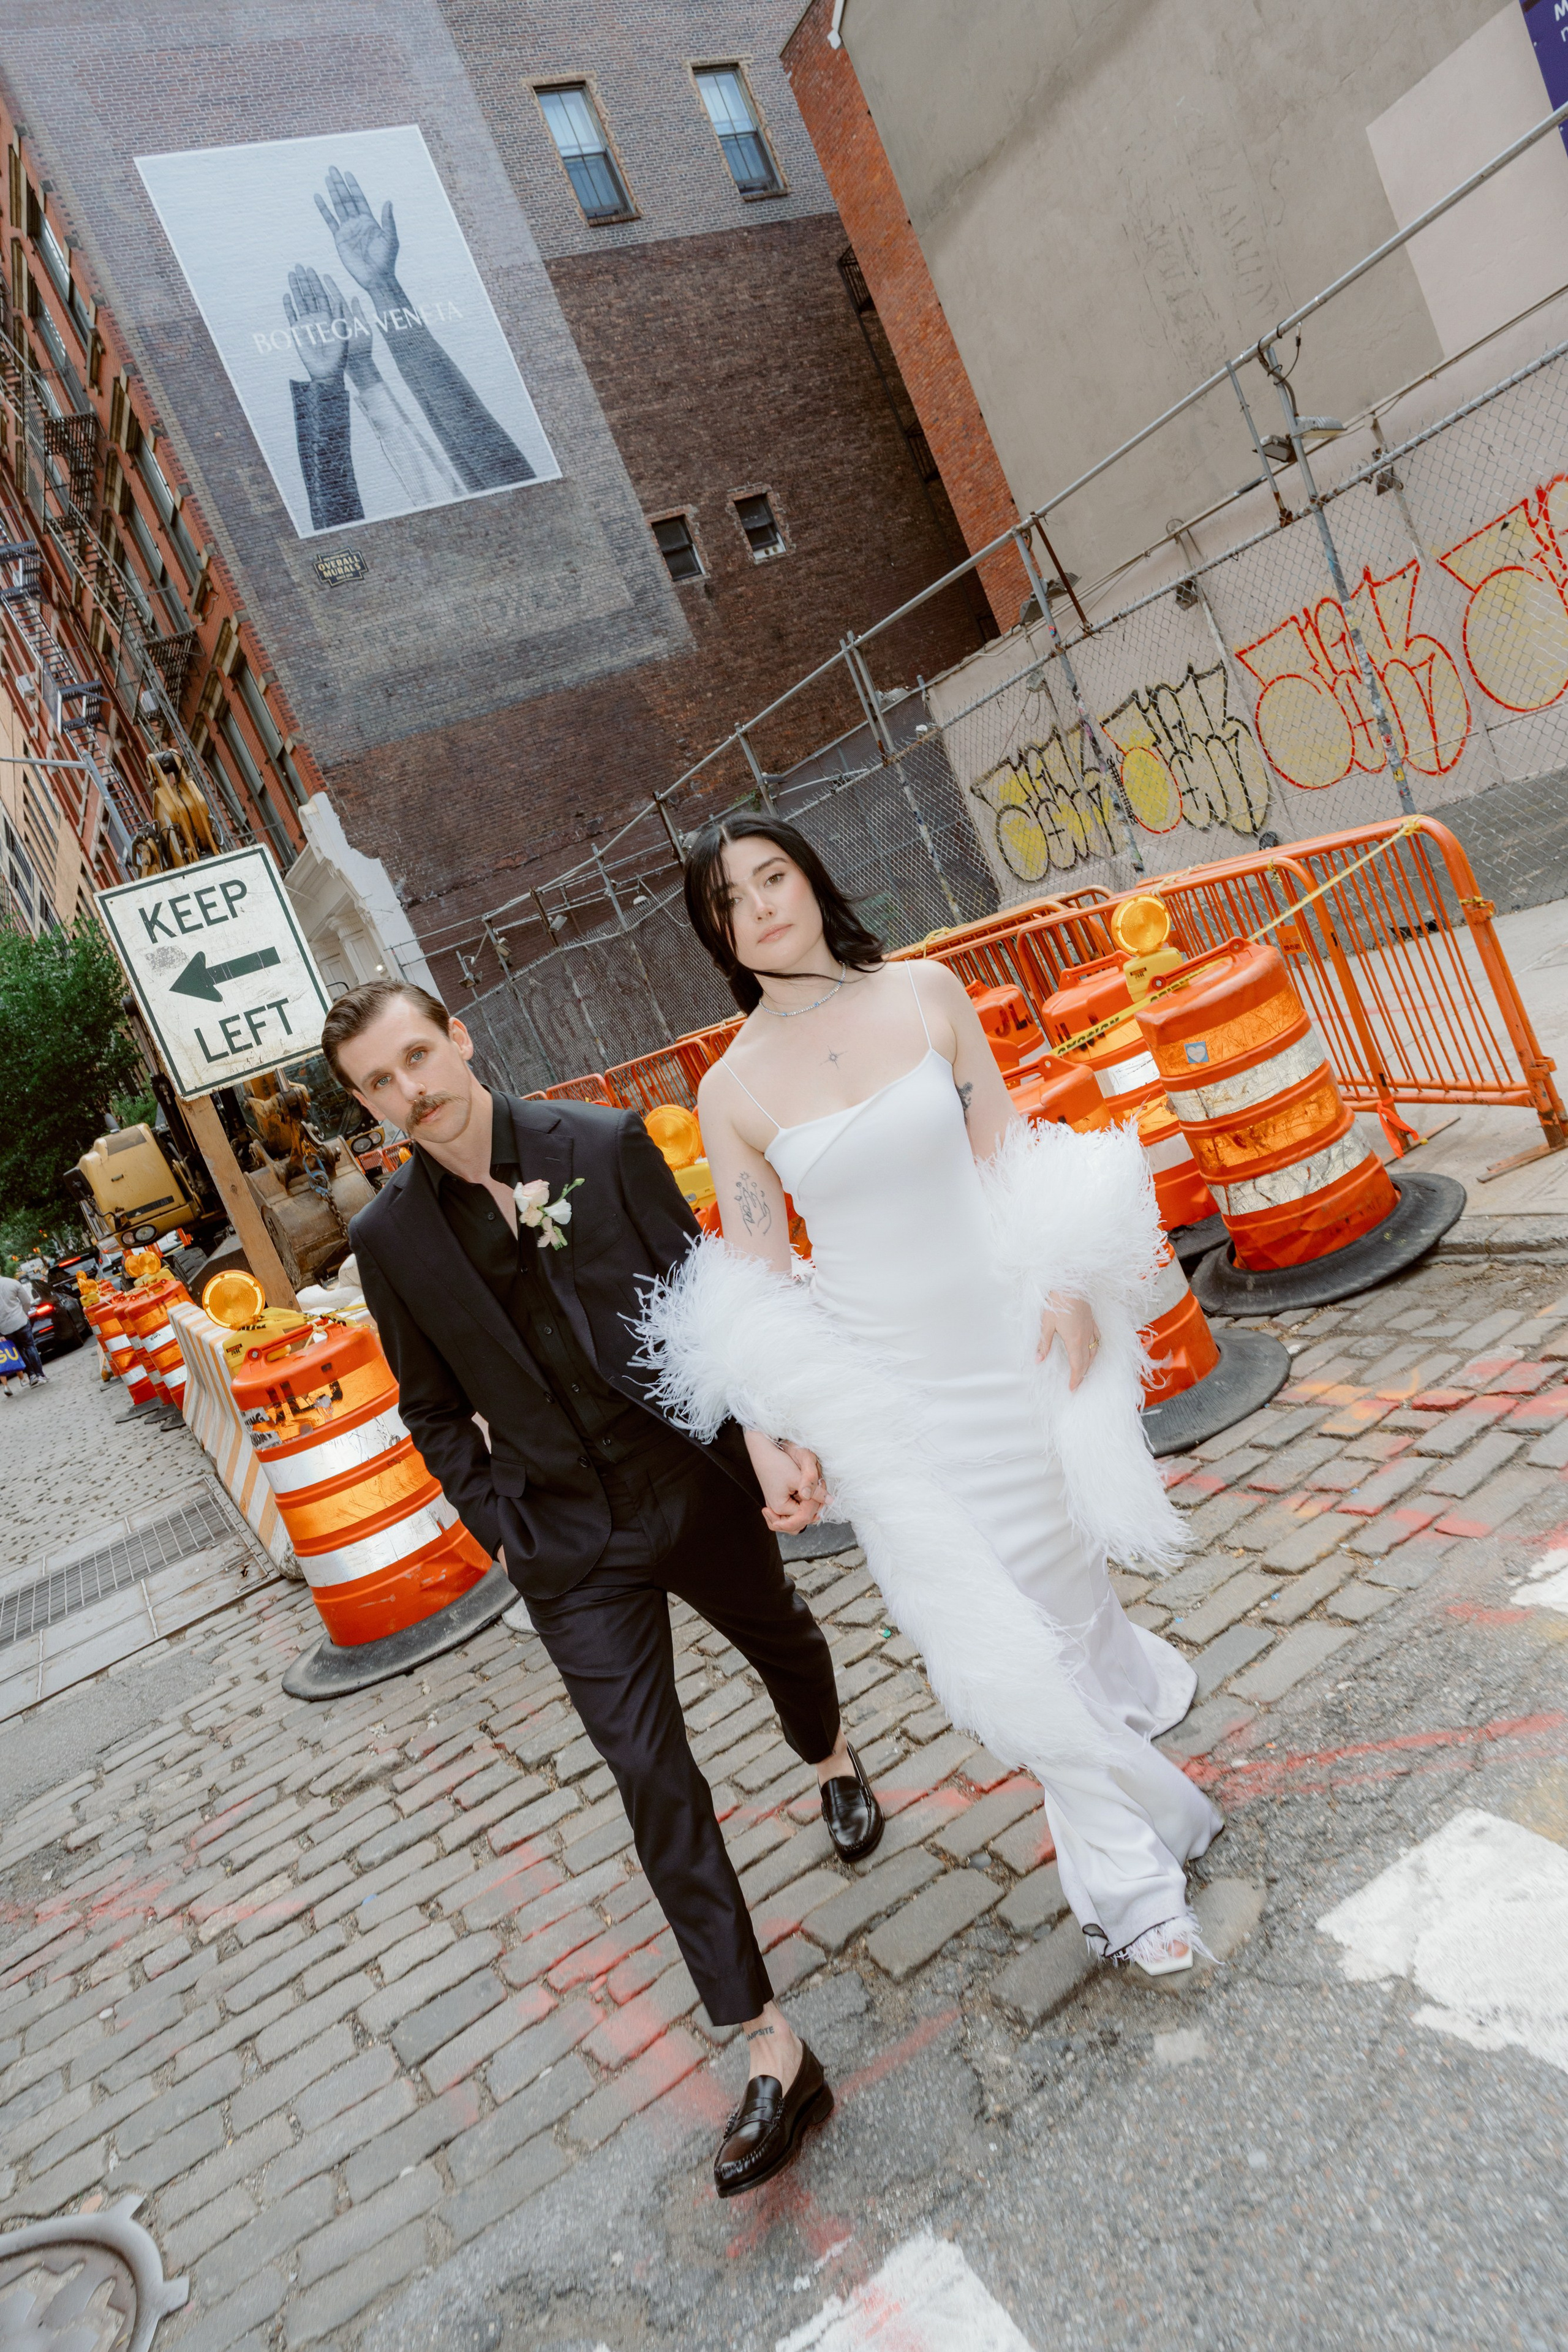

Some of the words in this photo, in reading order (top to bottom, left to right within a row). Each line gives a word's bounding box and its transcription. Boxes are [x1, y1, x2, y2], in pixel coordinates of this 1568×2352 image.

[252, 318, 370, 355] BOTTEGA
[318, 555, 360, 571] OVERALL
[323, 563, 361, 578] MURALS
[138, 879, 247, 944] KEEP
[194, 998, 293, 1063] LEFT
